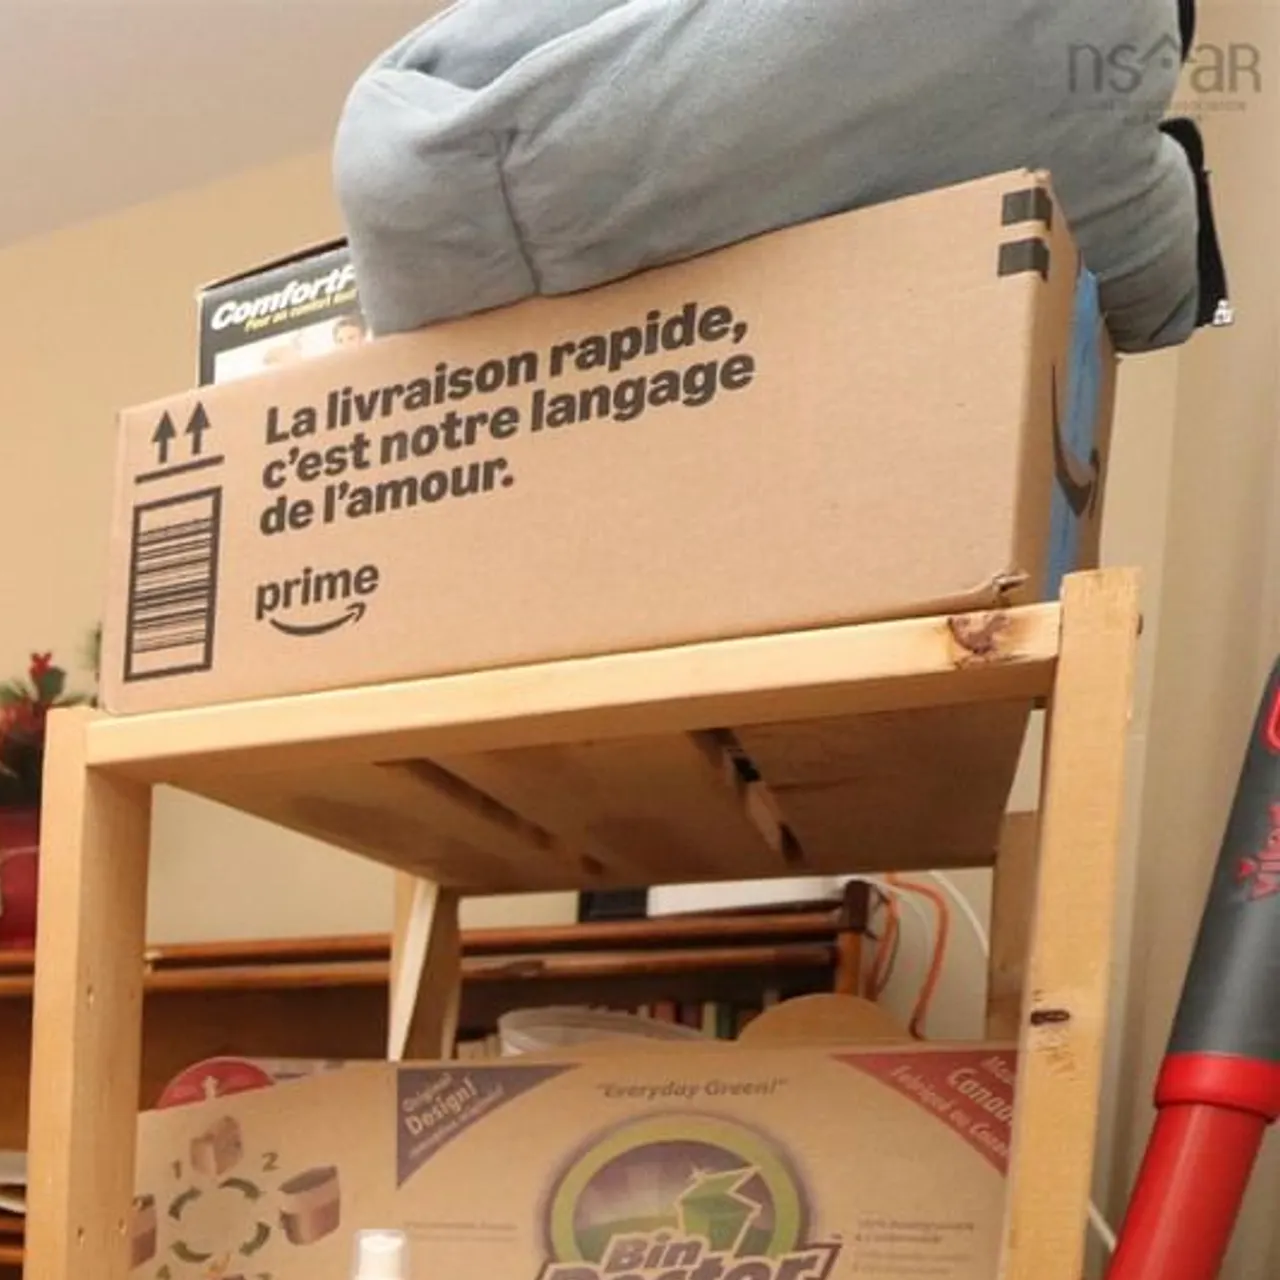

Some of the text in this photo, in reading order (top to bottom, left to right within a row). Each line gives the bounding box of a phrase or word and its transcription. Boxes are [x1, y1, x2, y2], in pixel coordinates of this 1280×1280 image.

[264, 303, 749, 444] La livraison rapide,
[261, 352, 754, 489] c'est notre langage
[259, 457, 515, 536] de l'amour.
[256, 561, 380, 620] prime
[405, 1076, 477, 1135] Design!
[171, 1159, 183, 1179] 1
[262, 1153, 279, 1171] 2
[607, 1233, 698, 1272] Bin
